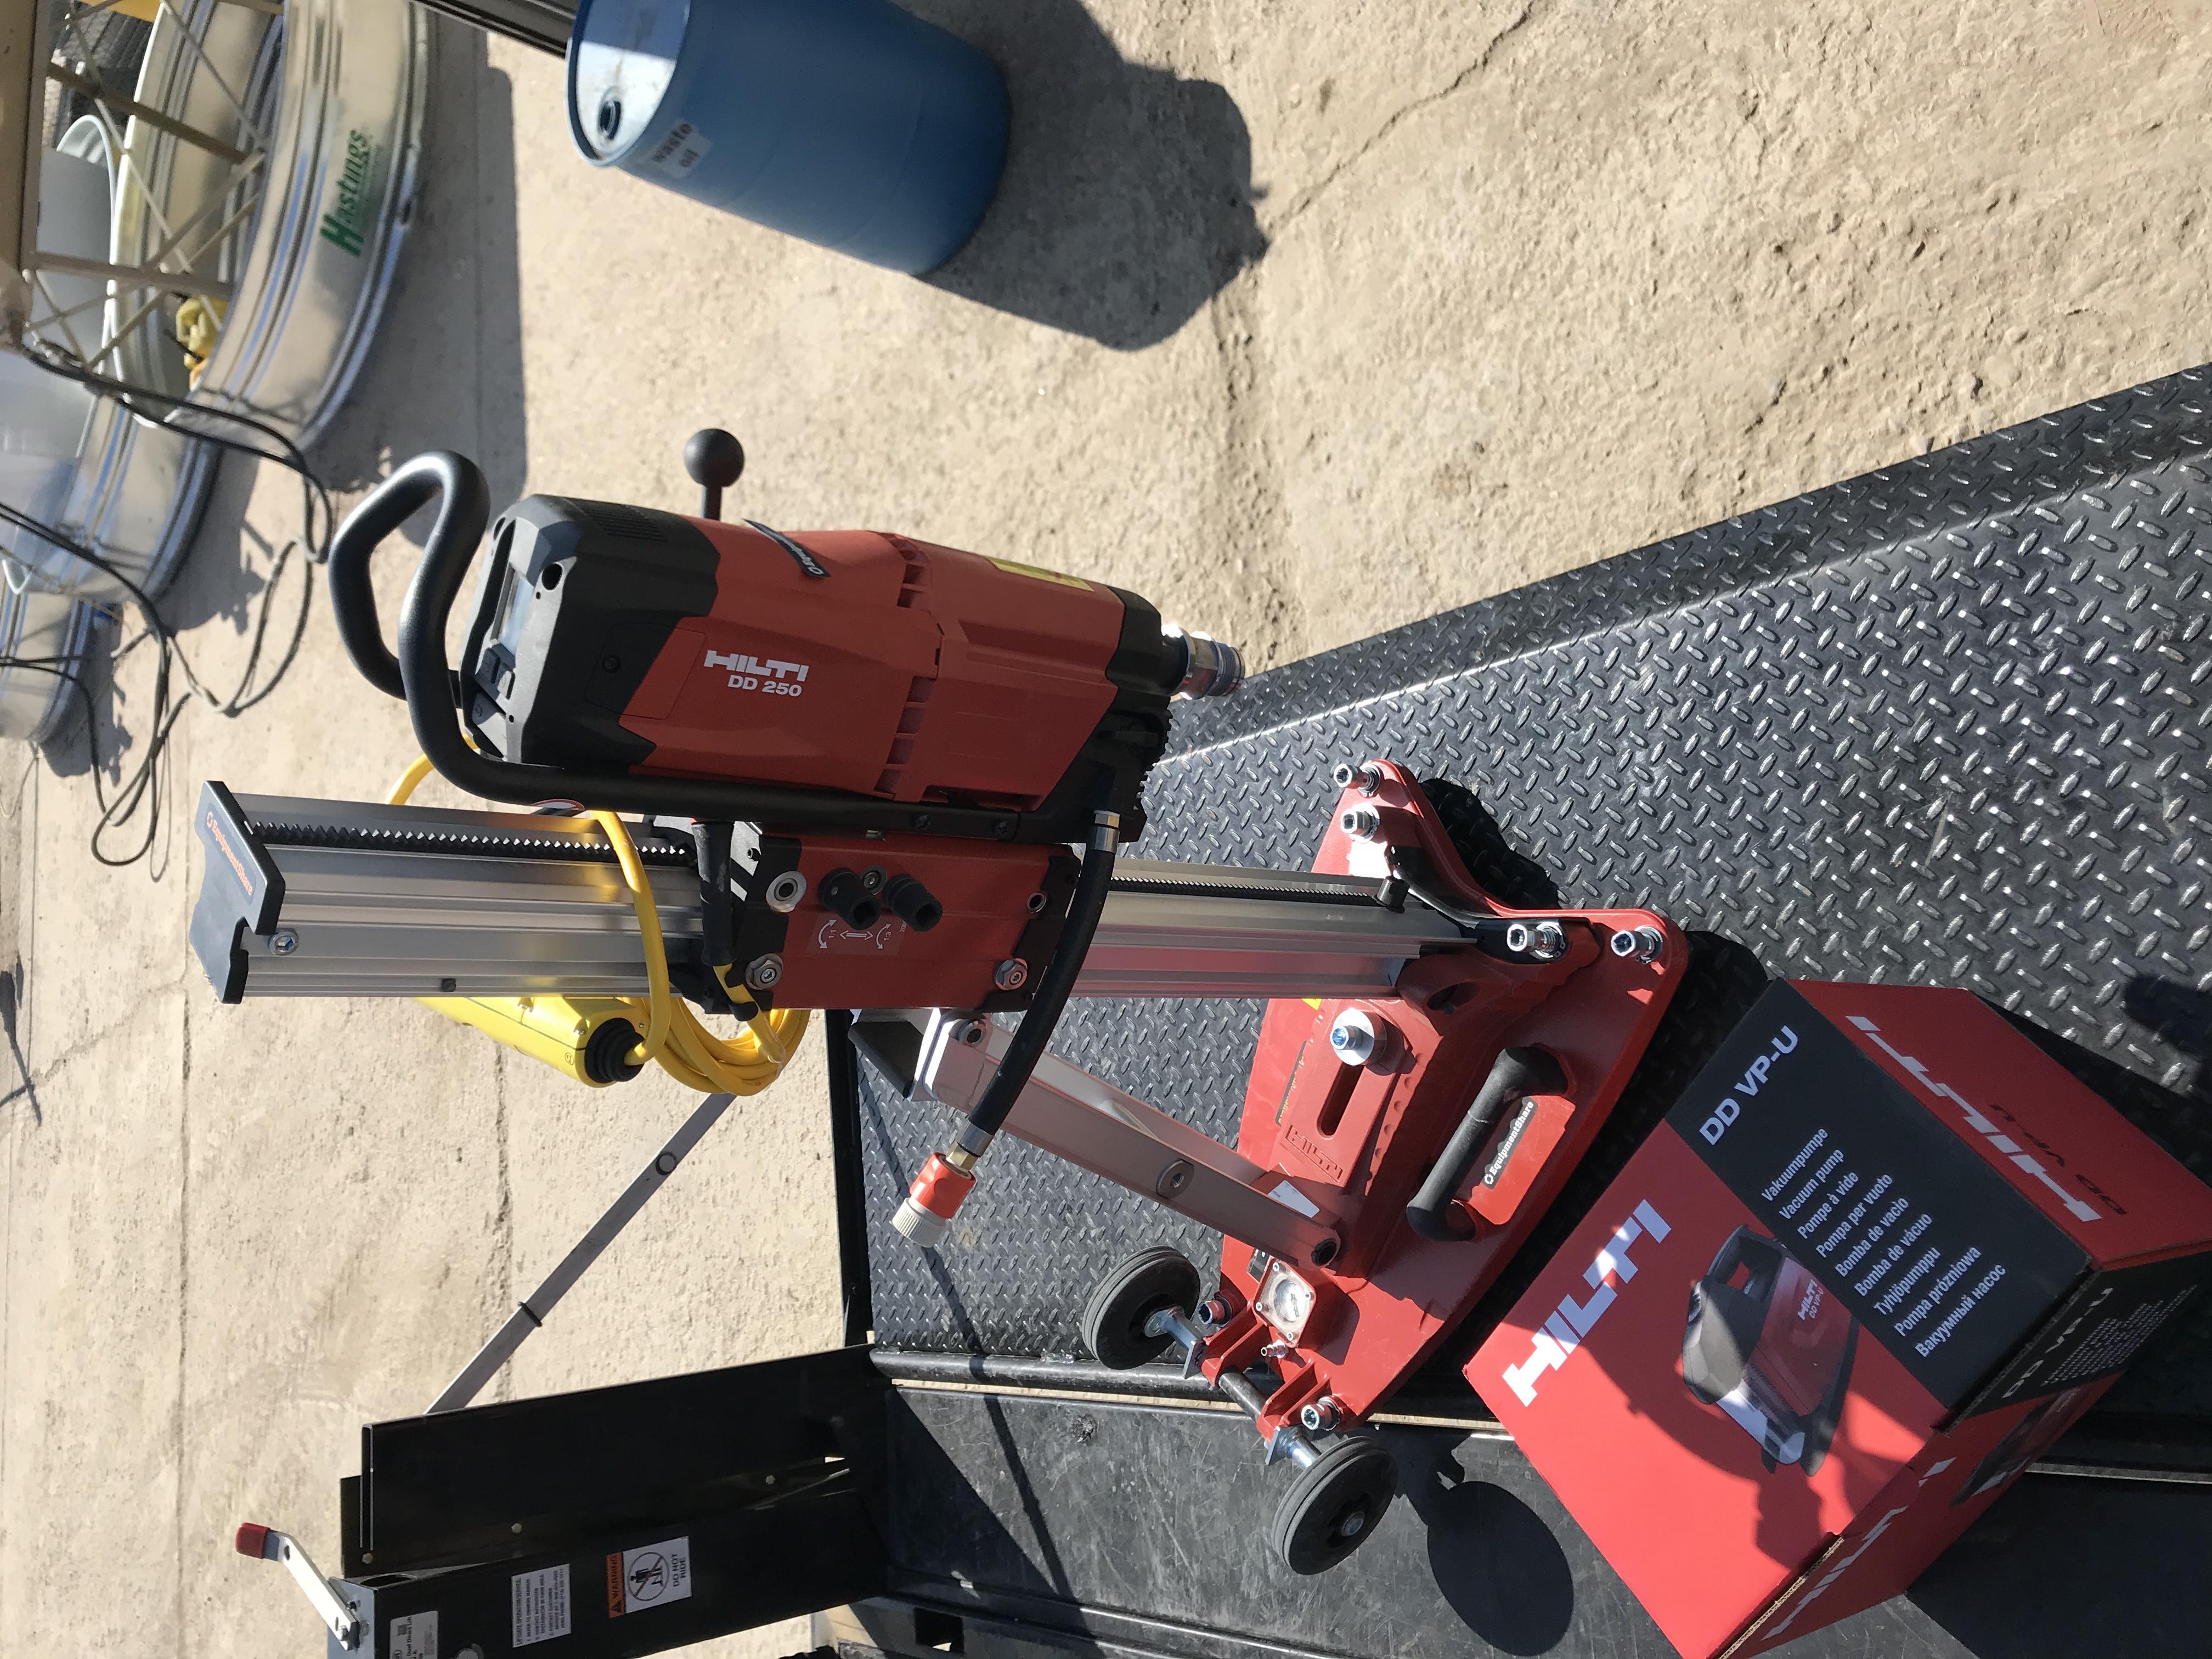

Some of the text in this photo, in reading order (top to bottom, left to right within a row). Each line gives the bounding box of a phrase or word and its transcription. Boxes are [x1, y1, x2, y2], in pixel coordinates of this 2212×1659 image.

[320, 129, 370, 257] Hastings
[704, 650, 809, 682] HILTI
[728, 675, 802, 697] DD 250
[212, 819, 253, 896] EquipmentShare
[1699, 1025, 1798, 1146] DD VP-U
[1845, 1015, 2103, 1222] HILTI
[1285, 1125, 1344, 1181] HILTI
[1489, 1101, 1534, 1176] EquipmentShare
[1761, 1128, 1828, 1201] Vakuumpumpe
[1779, 1149, 1844, 1220] Vacuum pump
[1797, 1203, 1832, 1239] Pompe
[1836, 1172, 1859, 1195] vide
[1815, 1174, 1893, 1258] Pompa per vuoto
[1835, 1239, 1872, 1277] Bomba
[1868, 1221, 1884, 1242] de
[1854, 1214, 1933, 1296] Bomba de vácuo
[1873, 1247, 1941, 1315] Tyhjöpumppu
[1502, 1199, 1672, 1407] HILTI
[1797, 1279, 1818, 1321] HILTI
[1809, 1305, 1818, 1319] DD
[1893, 1299, 1933, 1337] Pompa
[1915, 1264, 2006, 1357] Вакуумный насос
[2002, 1360, 2044, 1398] DD
[673, 1573, 680, 1587] DO
